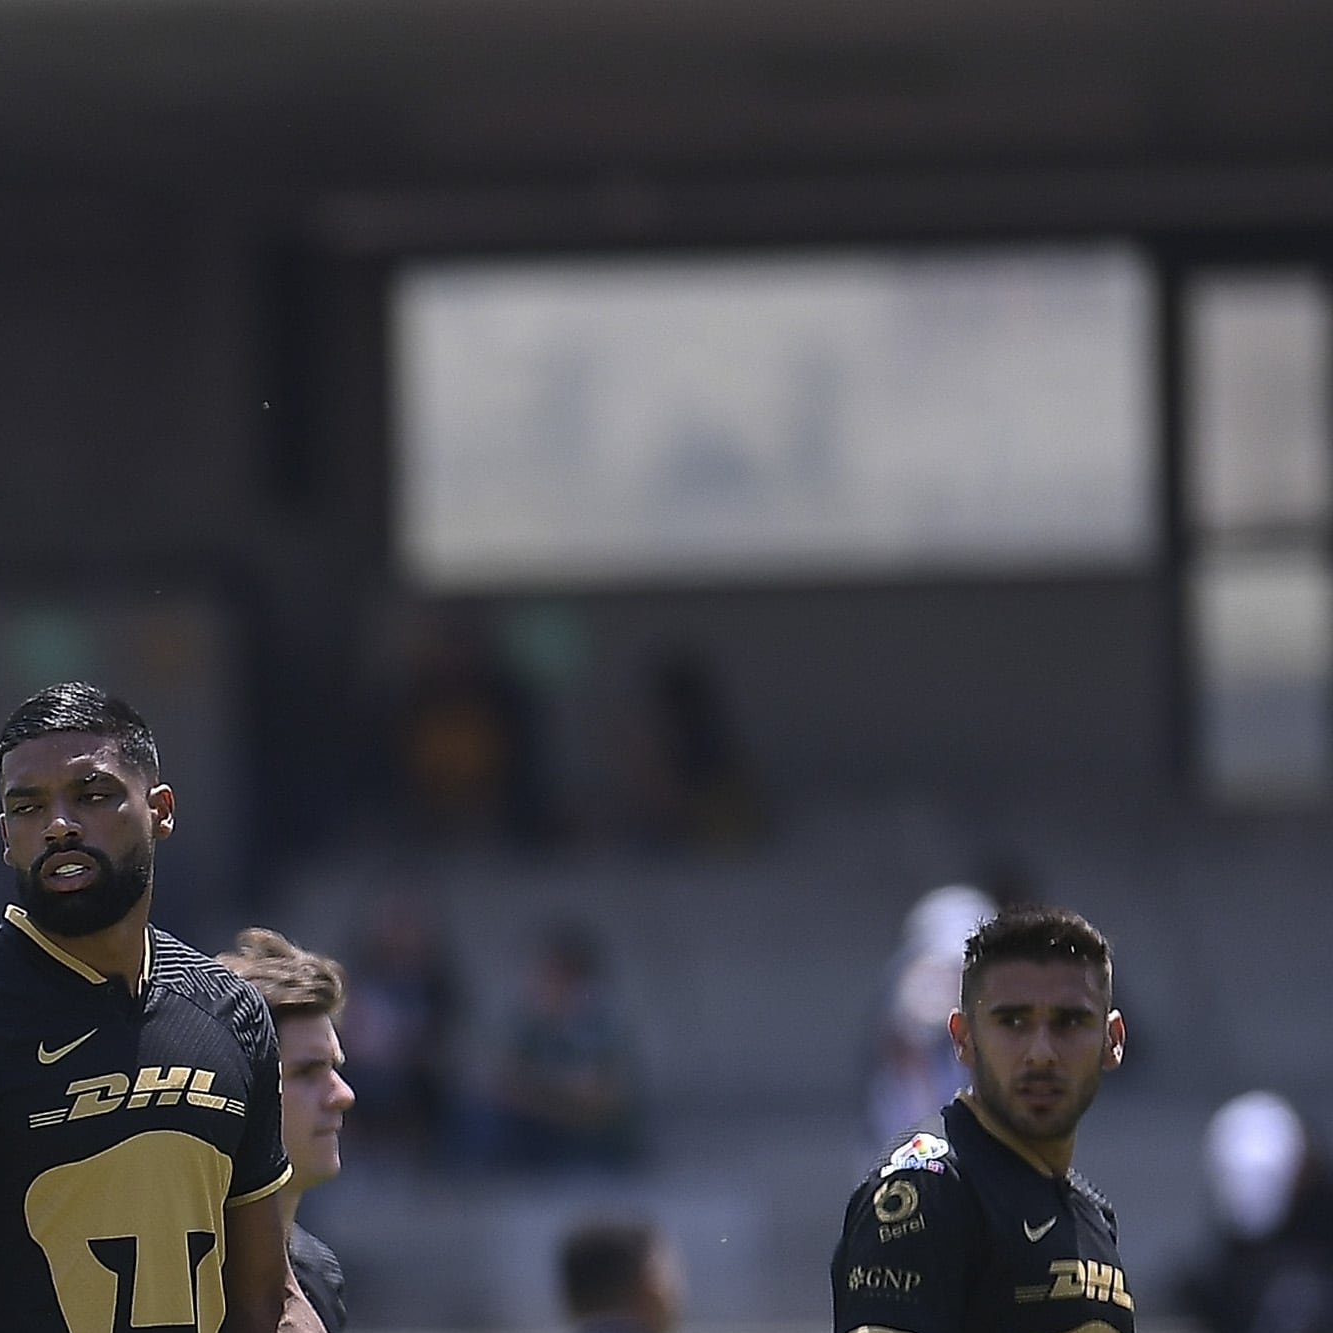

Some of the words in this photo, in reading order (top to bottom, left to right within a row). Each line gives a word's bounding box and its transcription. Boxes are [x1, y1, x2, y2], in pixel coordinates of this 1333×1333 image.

[66, 1066, 227, 1121] DHL
[878, 1214, 927, 1243] Berel
[866, 1266, 921, 1293] GNP
[1049, 1259, 1135, 1312] DHL
